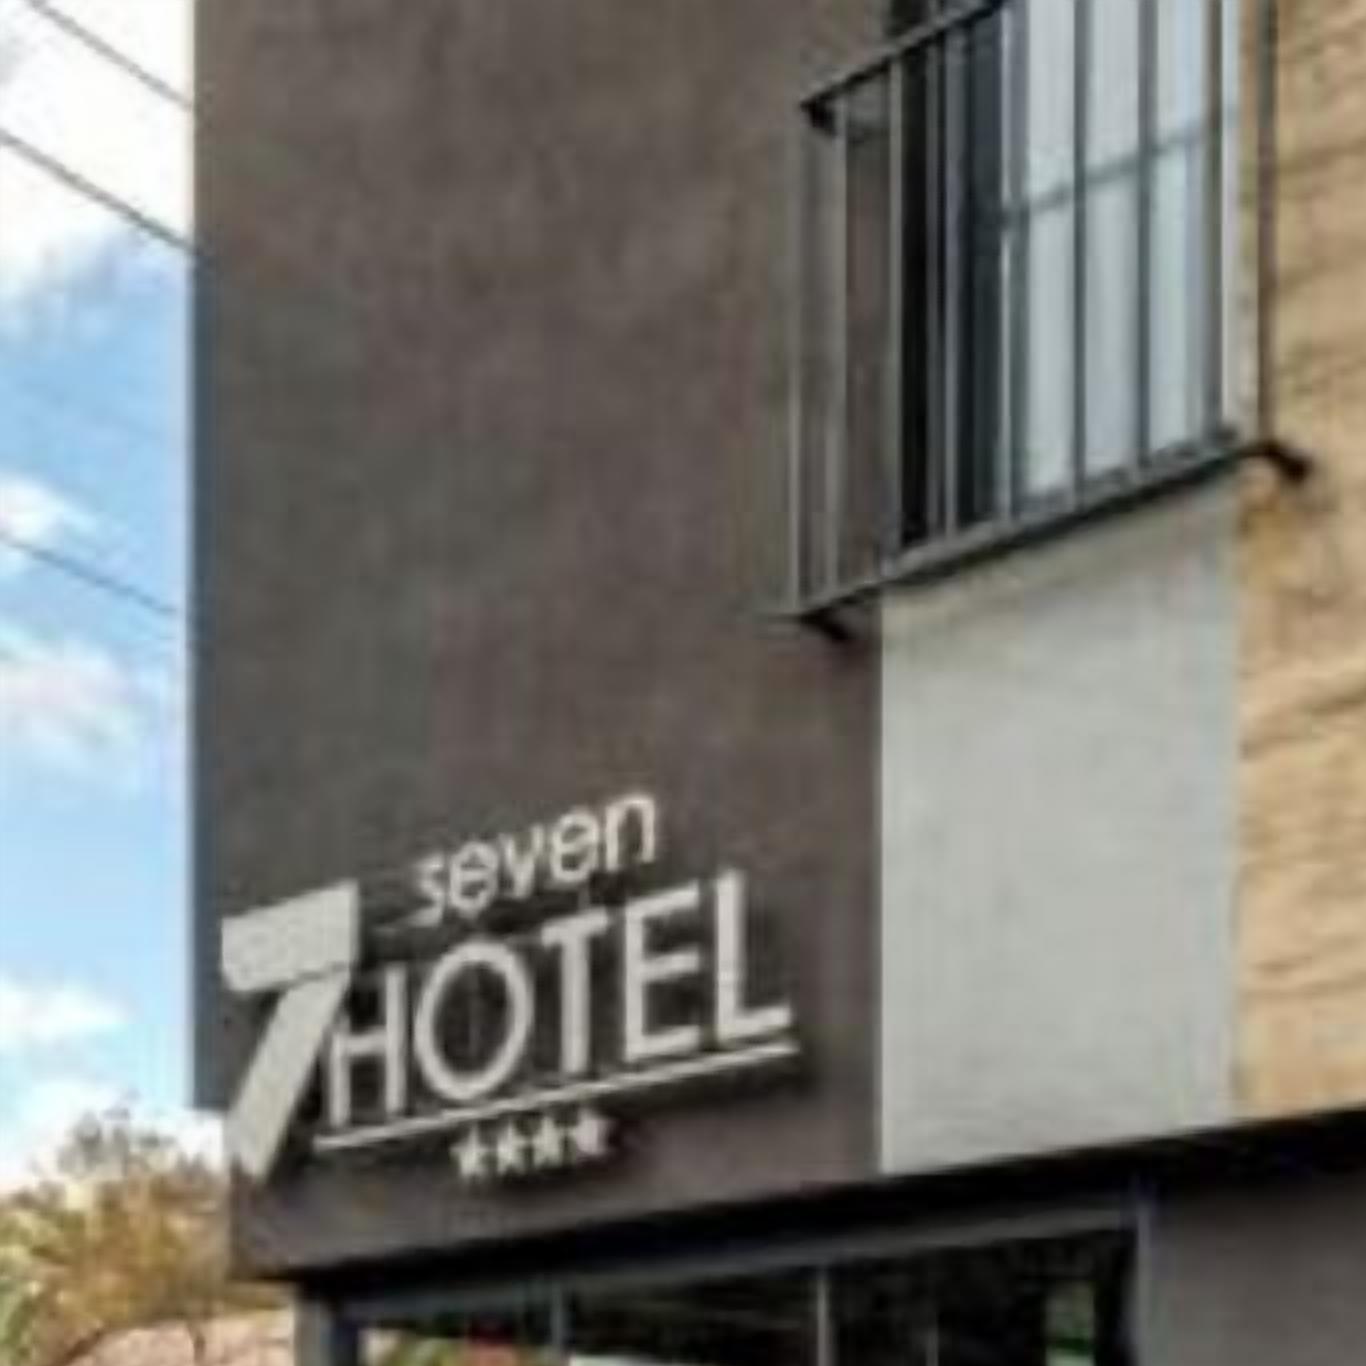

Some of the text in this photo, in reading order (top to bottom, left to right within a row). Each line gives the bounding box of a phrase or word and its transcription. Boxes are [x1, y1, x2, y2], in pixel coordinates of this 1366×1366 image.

[412, 792, 656, 926] seven
[221, 867, 793, 1182] 7 HOTEL
